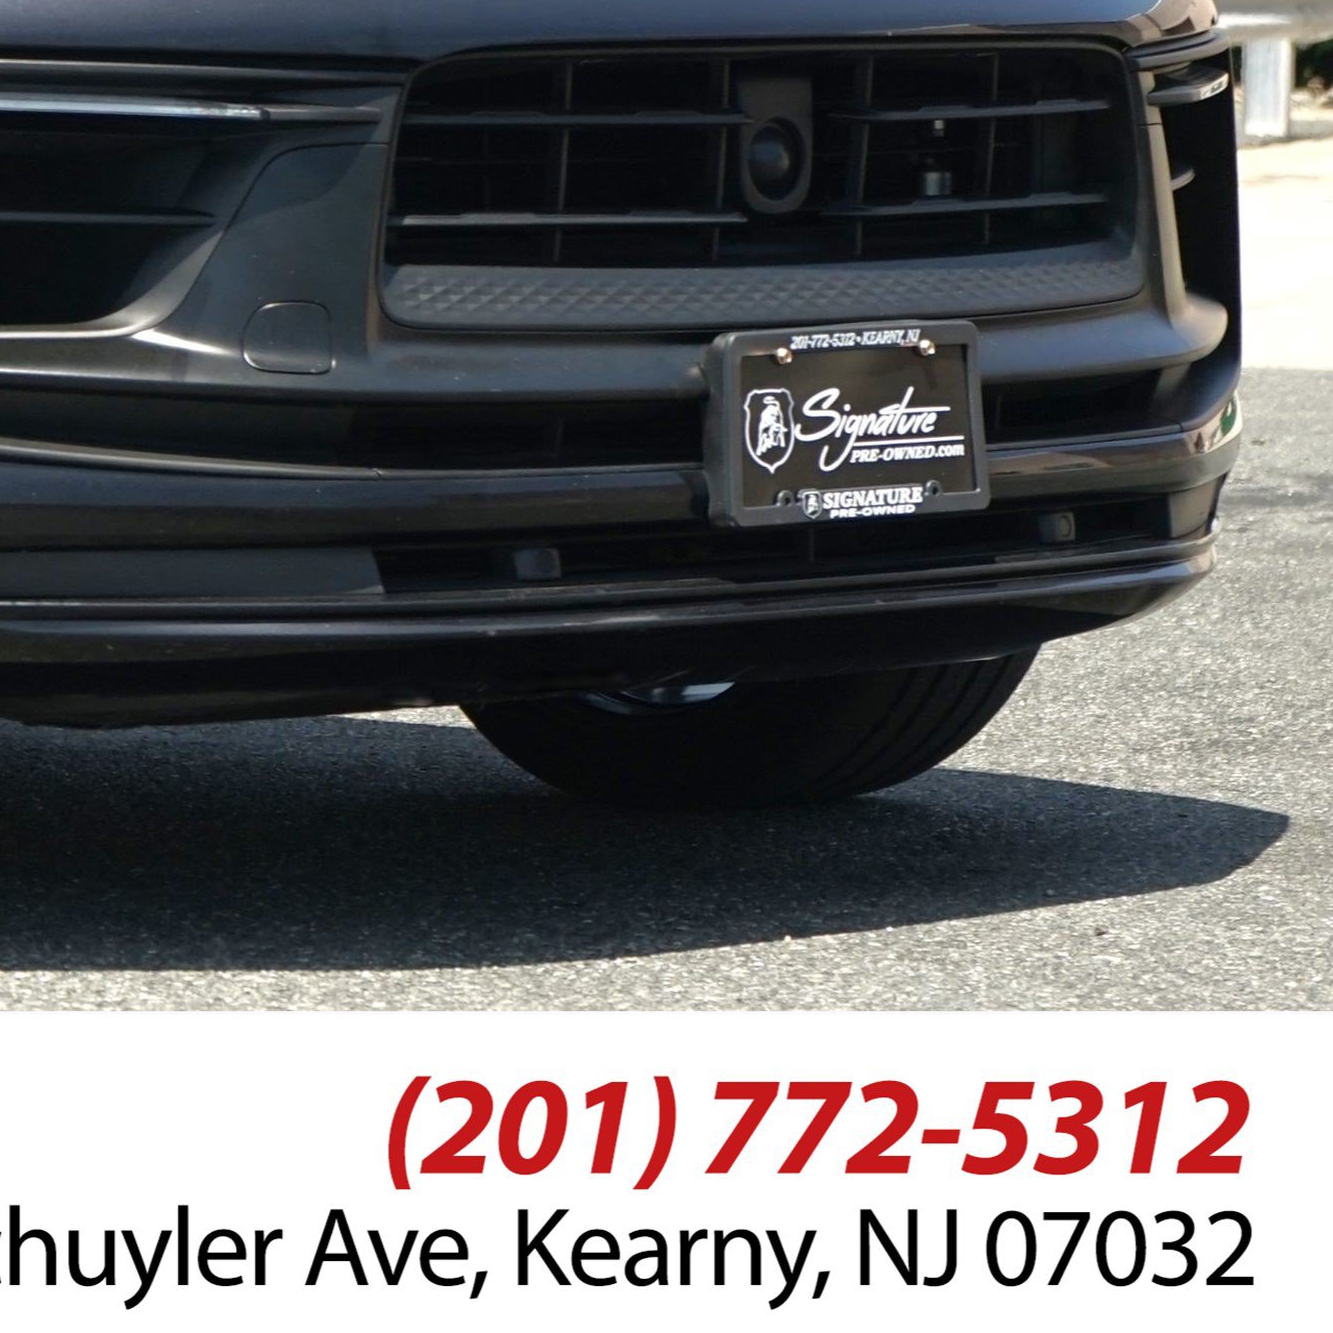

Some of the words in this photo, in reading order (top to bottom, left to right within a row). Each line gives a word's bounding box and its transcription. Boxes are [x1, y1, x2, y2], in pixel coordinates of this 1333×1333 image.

[794, 385, 952, 472] Signature
[849, 444, 965, 464] PRE-OWNED.com
[822, 486, 923, 509] SIGNATURE
[830, 504, 916, 519] PRE-OWNED
